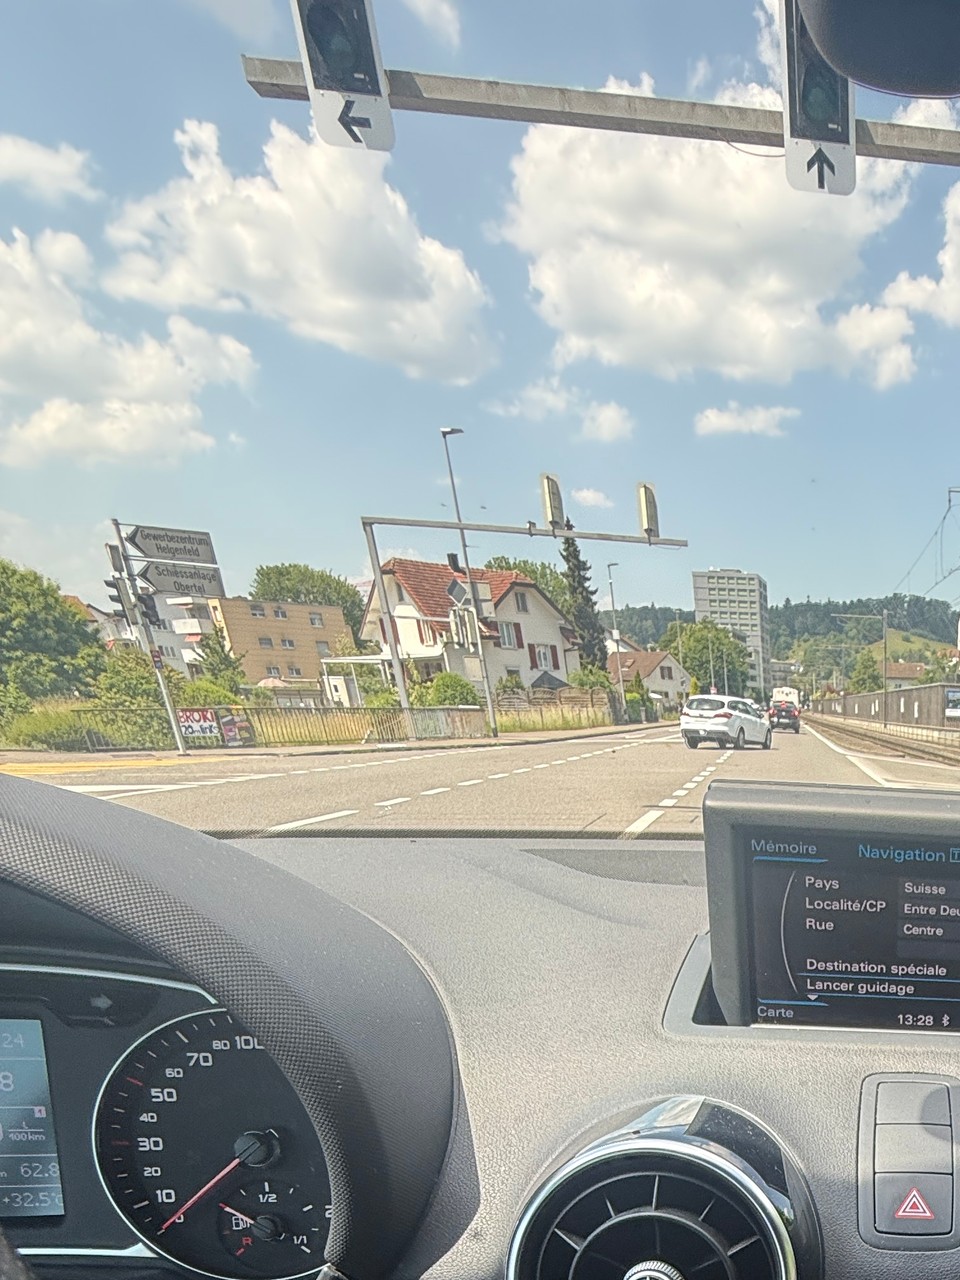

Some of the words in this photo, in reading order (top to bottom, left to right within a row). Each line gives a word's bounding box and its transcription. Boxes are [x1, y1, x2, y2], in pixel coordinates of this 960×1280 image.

[140, 529, 209, 546] Gewerbezentrum
[154, 565, 217, 583] Schiessanlage
[177, 709, 216, 724] BROKI
[751, 839, 817, 855] Mémoire
[858, 844, 946, 862] Navigation
[805, 876, 840, 891] Pays
[904, 882, 946, 895] Suisse
[805, 896, 886, 912] Localité/CP
[903, 904, 936, 916] Entre
[806, 918, 834, 931] Rue
[903, 924, 944, 936] Centre
[806, 958, 886, 973] Destination
[890, 963, 947, 977] spéciale
[806, 979, 854, 992] Lancer
[858, 982, 915, 997] guidage
[757, 1005, 794, 1018] Carte
[897, 1014, 934, 1026] 13:28
[212, 1040, 230, 1050] 80
[186, 1053, 213, 1067] 70
[165, 1068, 183, 1078] 60
[150, 1088, 178, 1102] 50
[139, 1113, 158, 1122] 40
[137, 1137, 164, 1151] 30
[20, 1162, 60, 1178] 62.8
[143, 1166, 161, 1176] 20
[156, 1189, 176, 1203] 10
[259, 1193, 277, 1203] 1/2
[242, 1236, 253, 1246] R
[293, 1235, 307, 1245] 1/1
